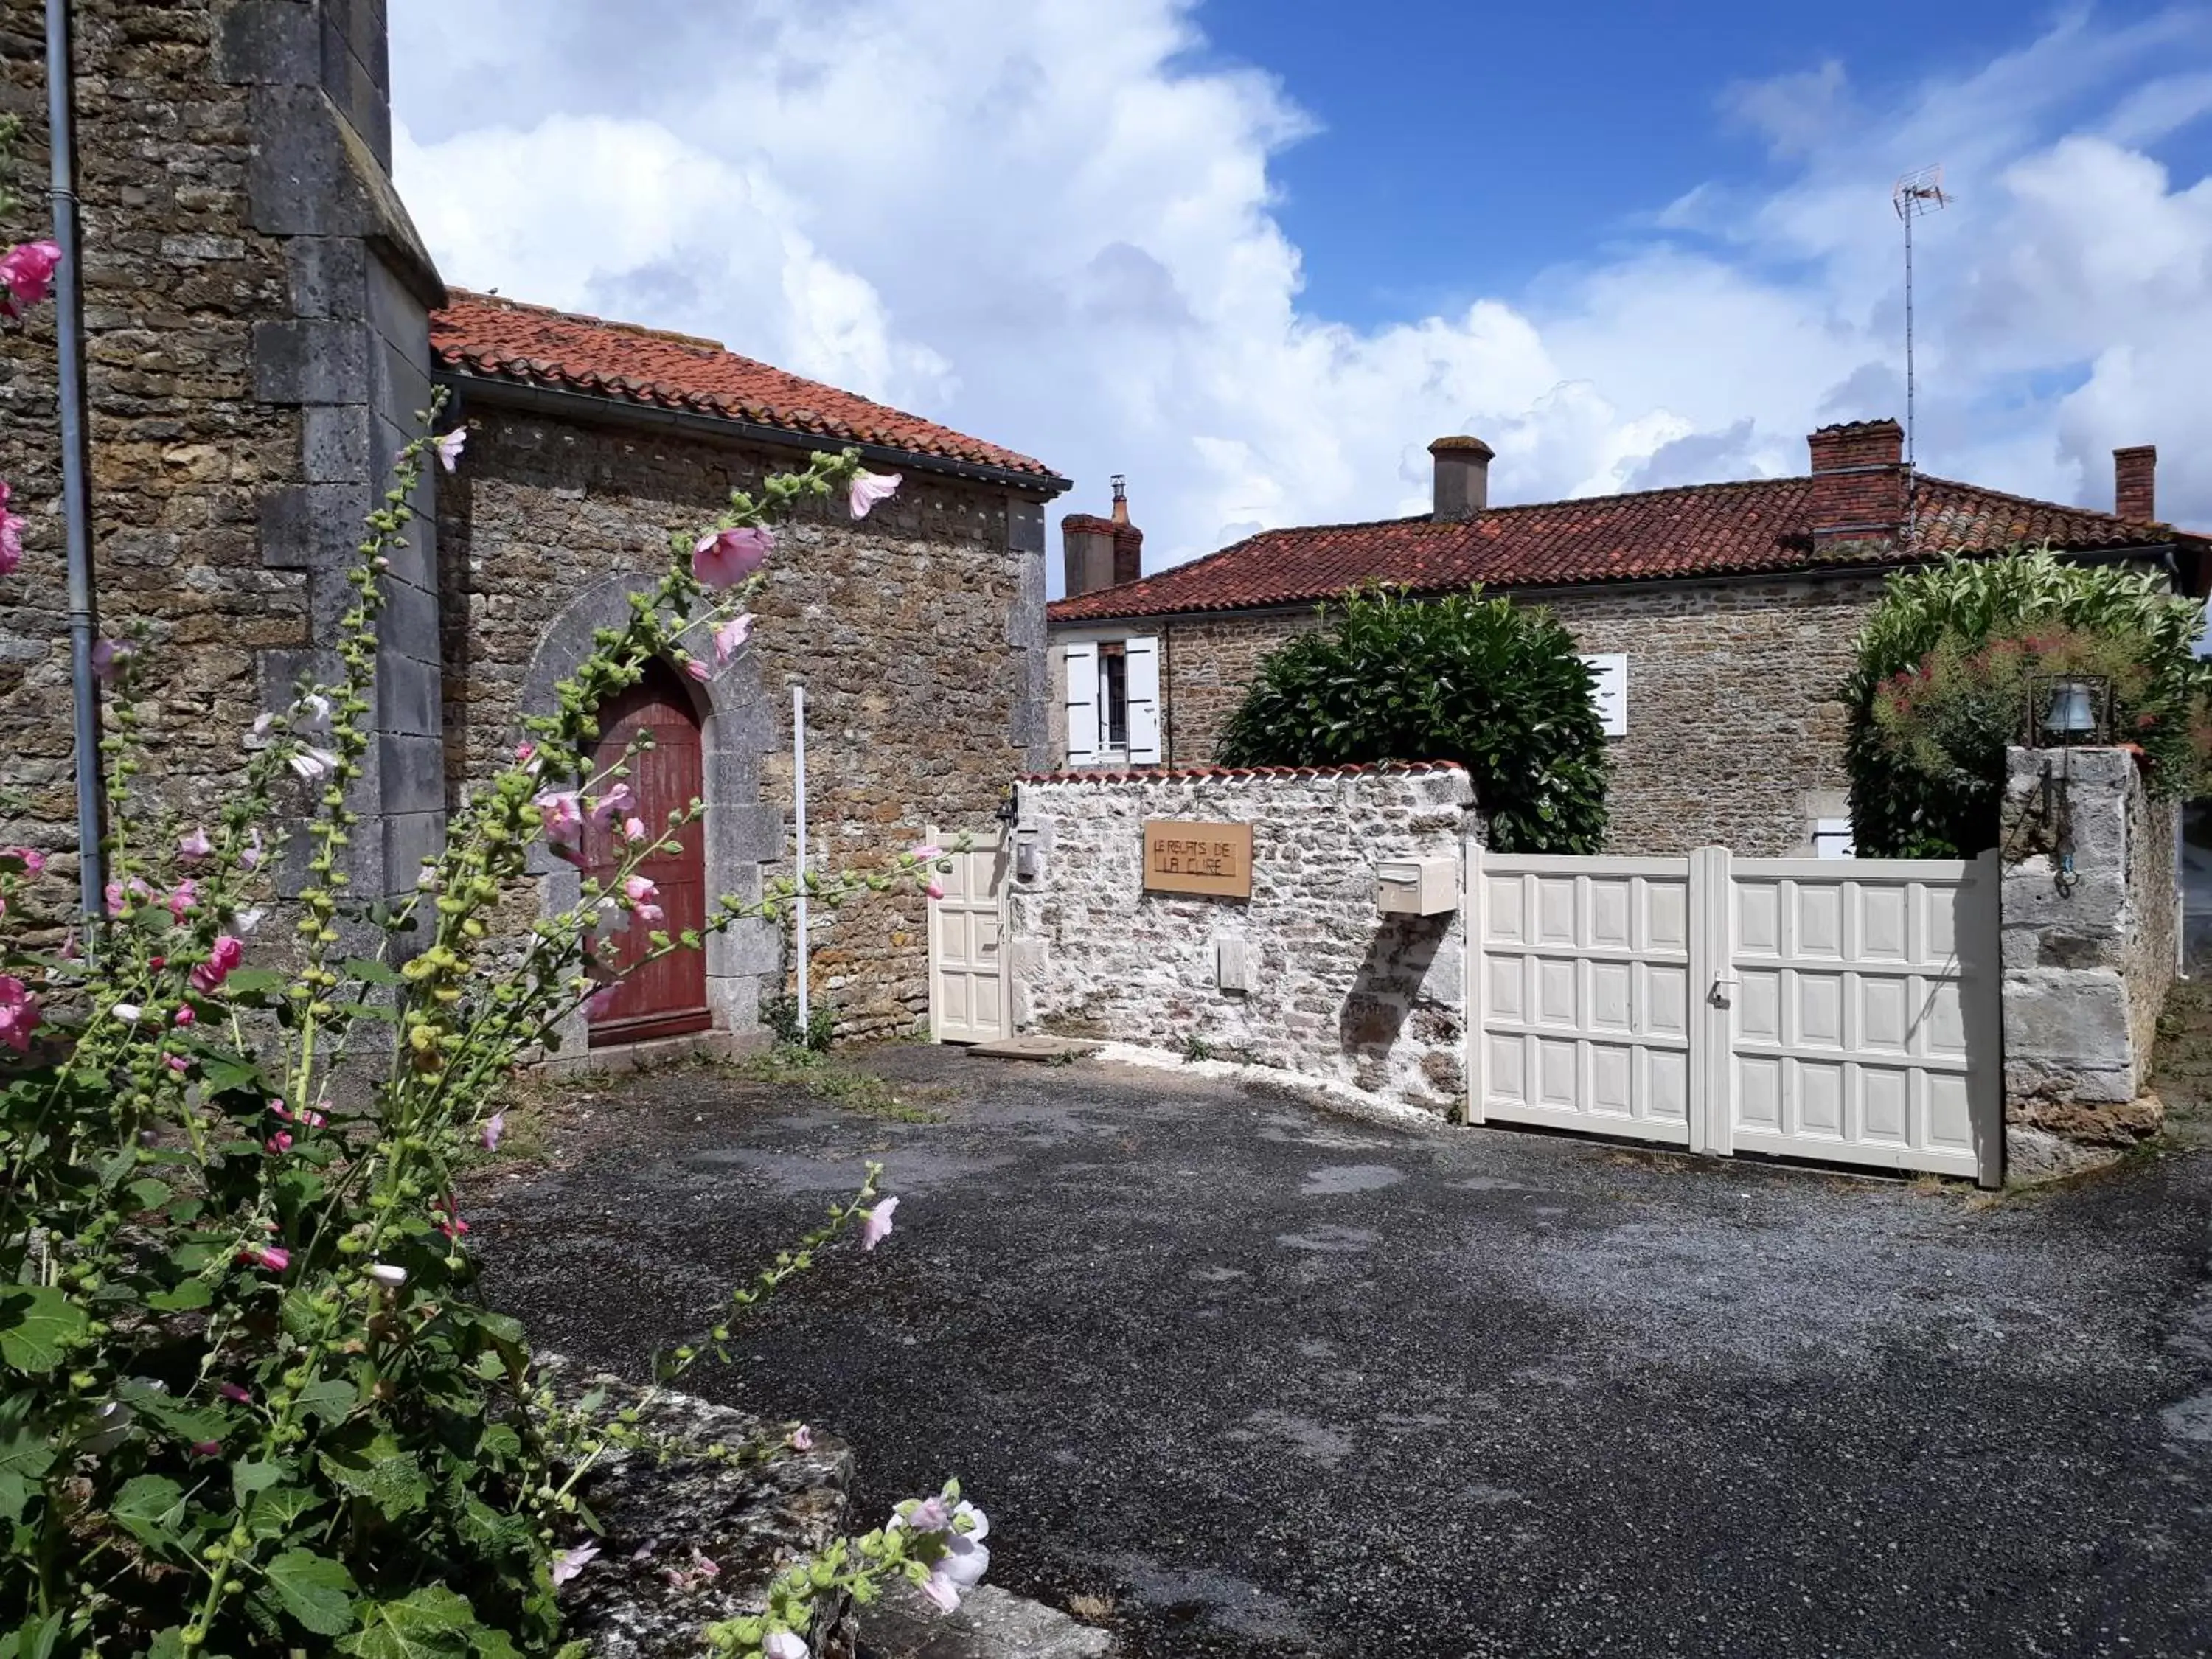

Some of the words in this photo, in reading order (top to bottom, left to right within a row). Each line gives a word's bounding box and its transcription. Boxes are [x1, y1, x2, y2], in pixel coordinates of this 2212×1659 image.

[1155, 839, 1164, 852] LE
[1214, 843, 1231, 857] DE
[1164, 857, 1179, 873] LA
